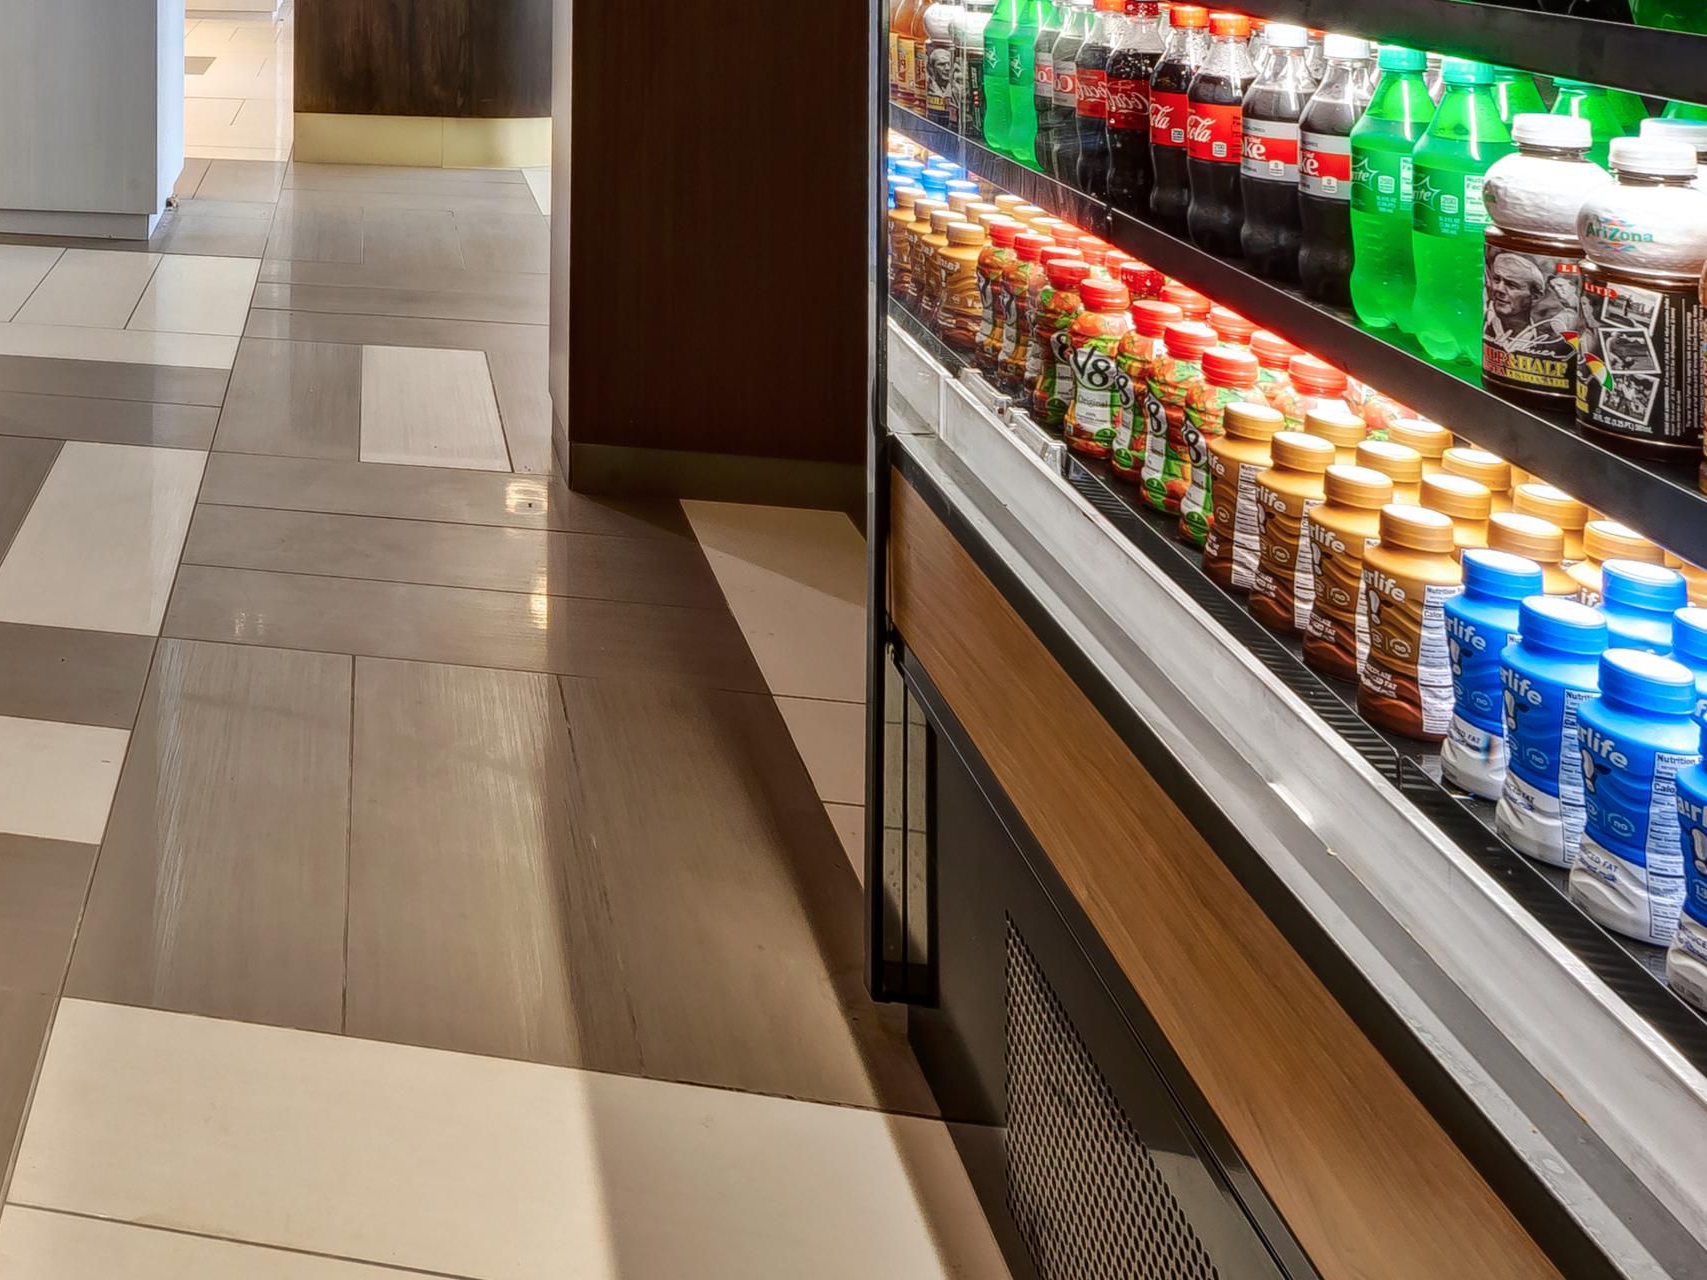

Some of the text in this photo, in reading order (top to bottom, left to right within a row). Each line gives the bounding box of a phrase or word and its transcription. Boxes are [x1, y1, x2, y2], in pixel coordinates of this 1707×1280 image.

[1584, 281, 1612, 298] LITE
[1072, 345, 1112, 388] V8
[1427, 586, 1456, 595] Nutrition
[1656, 753, 1696, 767] Nutrition
[1654, 782, 1677, 794] Calo
[1602, 861, 1619, 874] FAT
